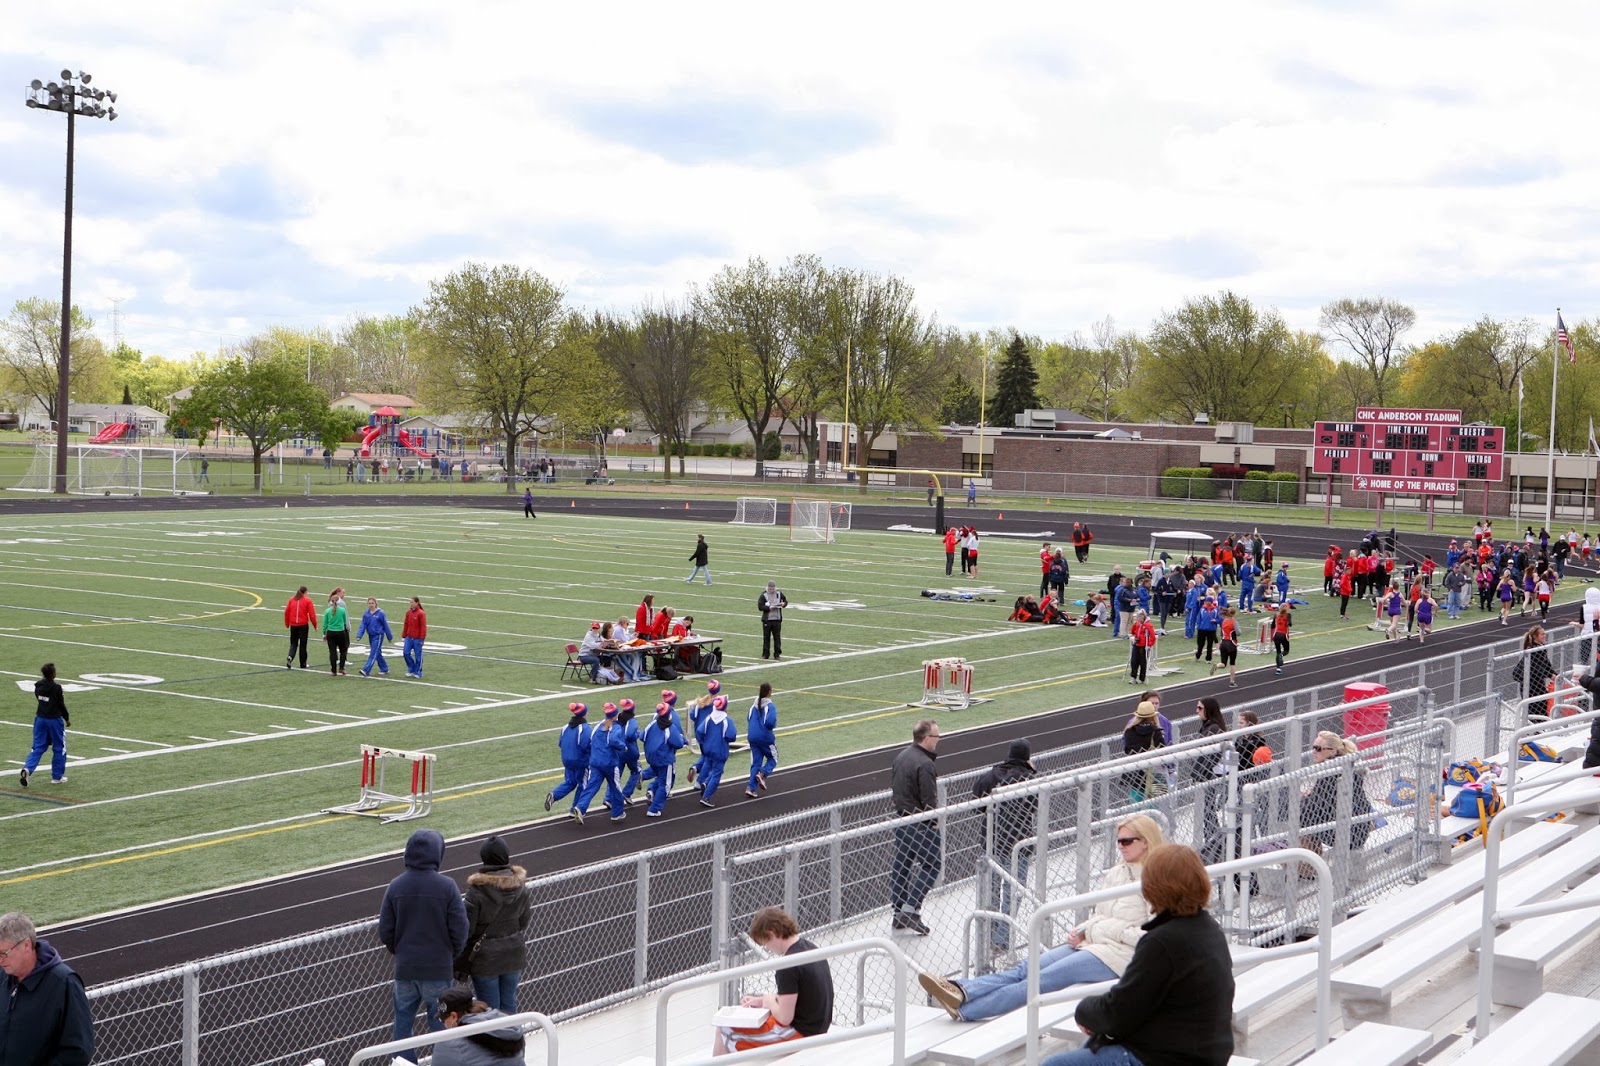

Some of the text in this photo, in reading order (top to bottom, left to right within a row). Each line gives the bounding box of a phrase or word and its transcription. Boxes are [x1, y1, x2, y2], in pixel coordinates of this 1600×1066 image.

[1357, 411, 1459, 422] CHIC ANDERSON STADIUM
[1335, 424, 1353, 432] HOME
[1387, 425, 1428, 434] TIME TO PLAY
[1459, 427, 1486, 436] GUESTS
[1324, 449, 1349, 458] PERIOD
[1372, 451, 1392, 460] BALL ON
[1421, 453, 1438, 462] DOWN
[1370, 479, 1455, 491] HOME OF THE PIRATES
